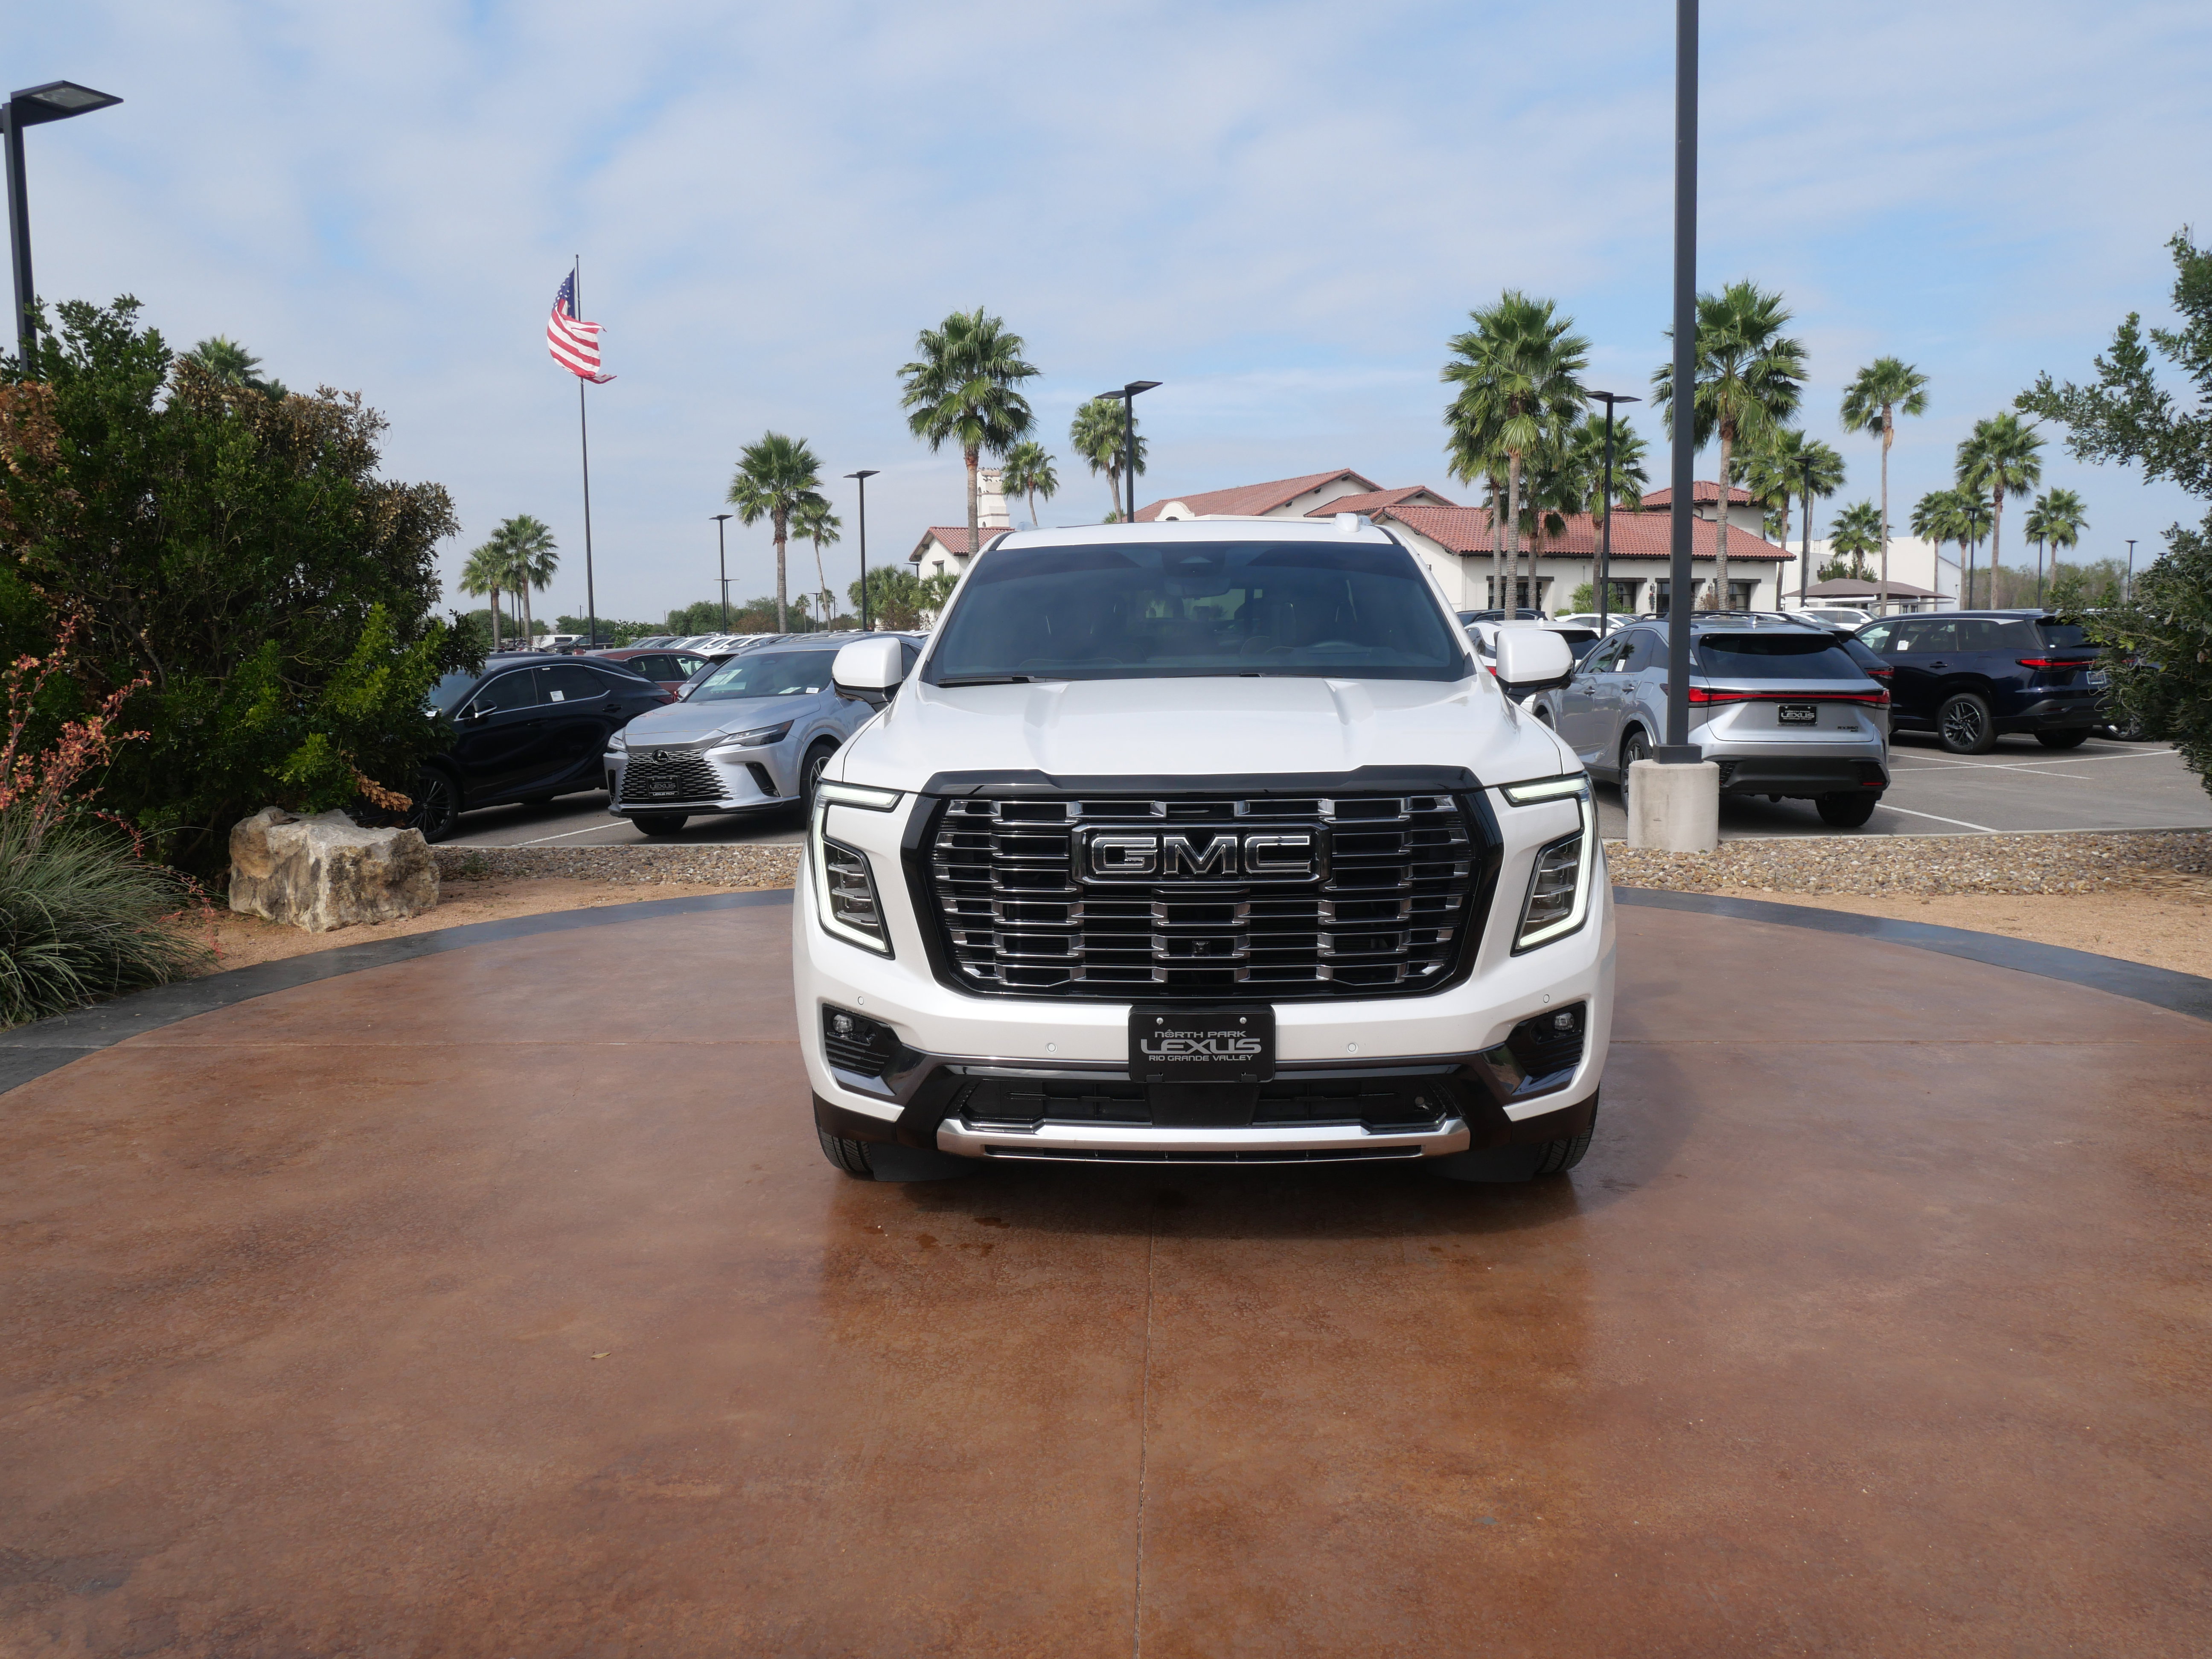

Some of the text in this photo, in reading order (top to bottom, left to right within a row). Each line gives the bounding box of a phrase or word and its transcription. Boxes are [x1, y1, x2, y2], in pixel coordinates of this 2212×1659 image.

[1090, 833, 1311, 874] GMC
[1154, 1029, 1203, 1038] NORTH
[1141, 1038, 1262, 1054] LEXUS
